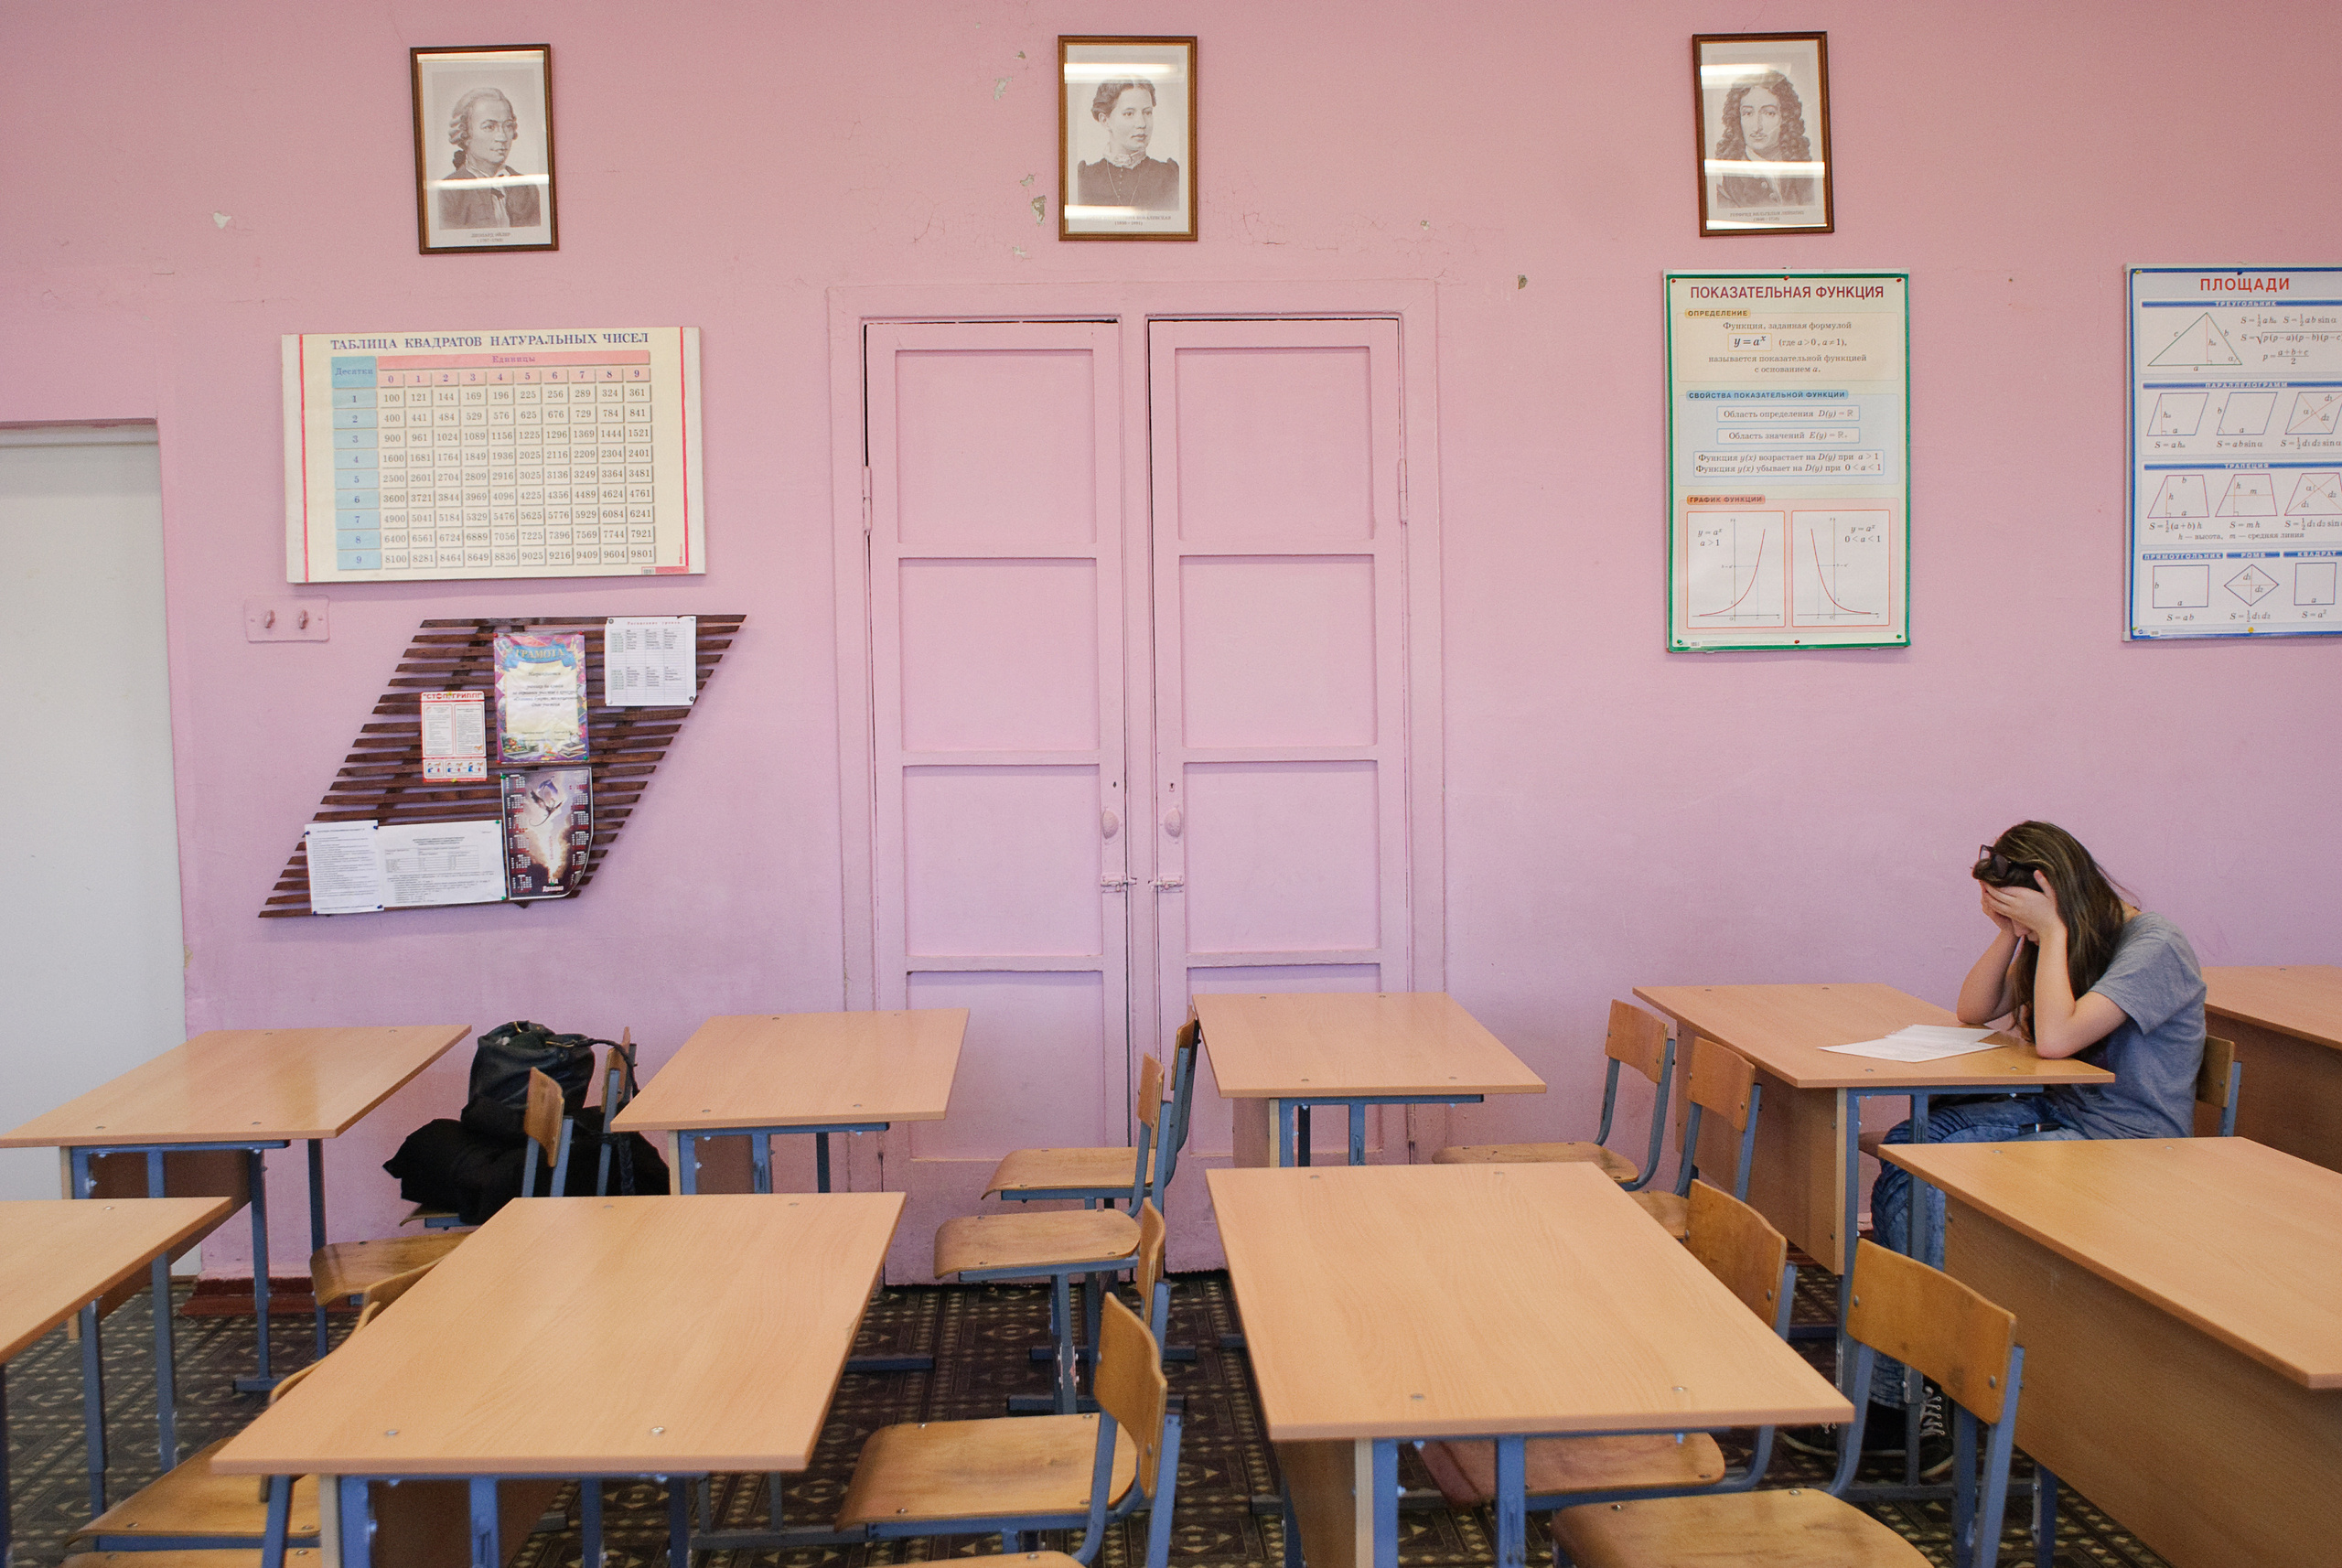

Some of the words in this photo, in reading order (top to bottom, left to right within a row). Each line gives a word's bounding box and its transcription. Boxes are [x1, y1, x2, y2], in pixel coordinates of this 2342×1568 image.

[1691, 286, 1811, 298] ПОКАЗАТЕЛЬНАЯ
[1816, 285, 1884, 300] ФУНКЦИЯ
[2200, 278, 2290, 293] ПЛОЩАДИ
[1809, 321, 1852, 331] формулой
[331, 338, 397, 350] ТАБЛИЦА
[404, 337, 482, 349] КВАДРАТОВ
[490, 333, 596, 346] НАТУРАЛЬНЫХ
[604, 333, 648, 344] ЧИСЕЛ
[492, 355, 536, 364] Единицы
[1758, 354, 1822, 363] показательной
[1824, 353, 1866, 364] функцией
[335, 368, 373, 377] Десятки
[388, 375, 394, 384] 0
[416, 375, 421, 383] 1
[443, 374, 448, 382] 2
[470, 373, 477, 382] 3
[498, 373, 503, 381] 4
[525, 372, 531, 381] 5
[552, 371, 558, 380] 6
[580, 371, 586, 380] 7
[634, 370, 640, 378] 9
[352, 395, 357, 403] 1
[384, 393, 400, 403] 100
[411, 392, 427, 402] 121
[438, 392, 455, 402] 144
[466, 392, 482, 401] 169
[493, 391, 510, 400] 196
[521, 390, 537, 400] 225
[547, 390, 564, 399] 256
[575, 389, 591, 398] 289
[602, 389, 618, 398] 324
[629, 388, 646, 397] 361
[1734, 391, 1804, 399] ПОКАЗАТЕЛЬНОЙ
[1806, 390, 1845, 399] ФУНКЦИИ
[353, 415, 358, 424] 2
[384, 413, 401, 423] 400
[412, 413, 428, 422] 441
[438, 412, 455, 422] 484
[466, 412, 482, 421] 529
[493, 411, 510, 420] 576
[521, 410, 537, 420] 625
[548, 410, 564, 419] 676
[575, 409, 592, 418] 729
[602, 409, 618, 418] 784
[629, 408, 646, 417] 841
[1724, 410, 1756, 419] Область
[1758, 411, 1813, 419] определения
[353, 435, 359, 444] 3
[384, 434, 401, 443] 900
[412, 433, 428, 443] 961
[437, 432, 458, 442] 1024
[464, 432, 486, 441] 1089
[491, 431, 513, 441] 1156
[519, 430, 541, 440] 1225
[546, 430, 568, 439] 1296
[574, 429, 595, 439] 1369
[601, 429, 622, 438] 1444
[628, 428, 650, 437] 1521
[1729, 432, 1763, 441] Область
[1765, 431, 1805, 439] значений
[353, 456, 359, 464] 4
[382, 454, 404, 463] 1600
[410, 453, 432, 463] 1681
[437, 452, 459, 462] 1764
[465, 452, 487, 461] 1849
[492, 451, 514, 461] 1936
[520, 450, 541, 460] 2025
[546, 450, 568, 459] 2116
[574, 449, 596, 459] 2209
[601, 449, 623, 458] 2304
[628, 448, 650, 457] 2401
[1698, 454, 1738, 463] Функция
[1758, 454, 1804, 463] возрастает
[354, 476, 360, 484] 5
[383, 474, 405, 483] 2500
[411, 473, 433, 483] 2601
[437, 472, 460, 482] 2704
[465, 472, 487, 481] 2809
[492, 471, 514, 481] 2916
[520, 470, 542, 480] 3025
[547, 470, 569, 479] 3136
[575, 469, 596, 479] 3249
[602, 469, 623, 478] 3364
[628, 468, 650, 478] 3481
[1696, 465, 1736, 474] Функция
[354, 496, 360, 504] 6
[383, 494, 405, 503] 3600
[411, 493, 433, 503] 3721
[438, 492, 460, 502] 3844
[466, 492, 488, 501] 3969
[493, 491, 515, 501] 4096
[520, 490, 542, 500] 4225
[547, 490, 569, 499] 4356
[575, 489, 596, 499] 4489
[602, 489, 624, 499] 4624
[629, 489, 651, 498] 4761
[384, 514, 406, 523] 4900
[411, 513, 434, 523] 5041
[438, 512, 461, 522] 5184
[466, 512, 488, 521] 5329
[493, 511, 515, 521] 5476
[521, 510, 543, 521] 5625
[548, 510, 570, 520] 5776
[575, 510, 597, 520] 5929
[602, 510, 624, 519] 6084
[629, 509, 651, 518] 6241
[355, 536, 361, 544] 8
[384, 534, 406, 543] 6400
[412, 533, 434, 543] 6561
[439, 532, 461, 542] 6724
[467, 532, 489, 542] 6889
[493, 532, 516, 542] 7056
[521, 531, 543, 541] 7225
[548, 531, 570, 540] 7396
[575, 530, 597, 540] 7569
[603, 530, 625, 539] 7744
[630, 529, 652, 538] 7921
[356, 556, 362, 564] 9
[384, 554, 407, 564] 8100
[412, 553, 435, 563] 8281
[439, 553, 462, 563] 8464
[467, 553, 489, 562] 8649
[494, 552, 516, 562] 8836
[521, 551, 543, 561] 9025
[549, 551, 571, 560] 9216
[576, 550, 598, 560] 9409
[603, 550, 626, 559] 9604
[630, 549, 652, 558] 9801
[516, 648, 564, 659] ГРАМОТА
